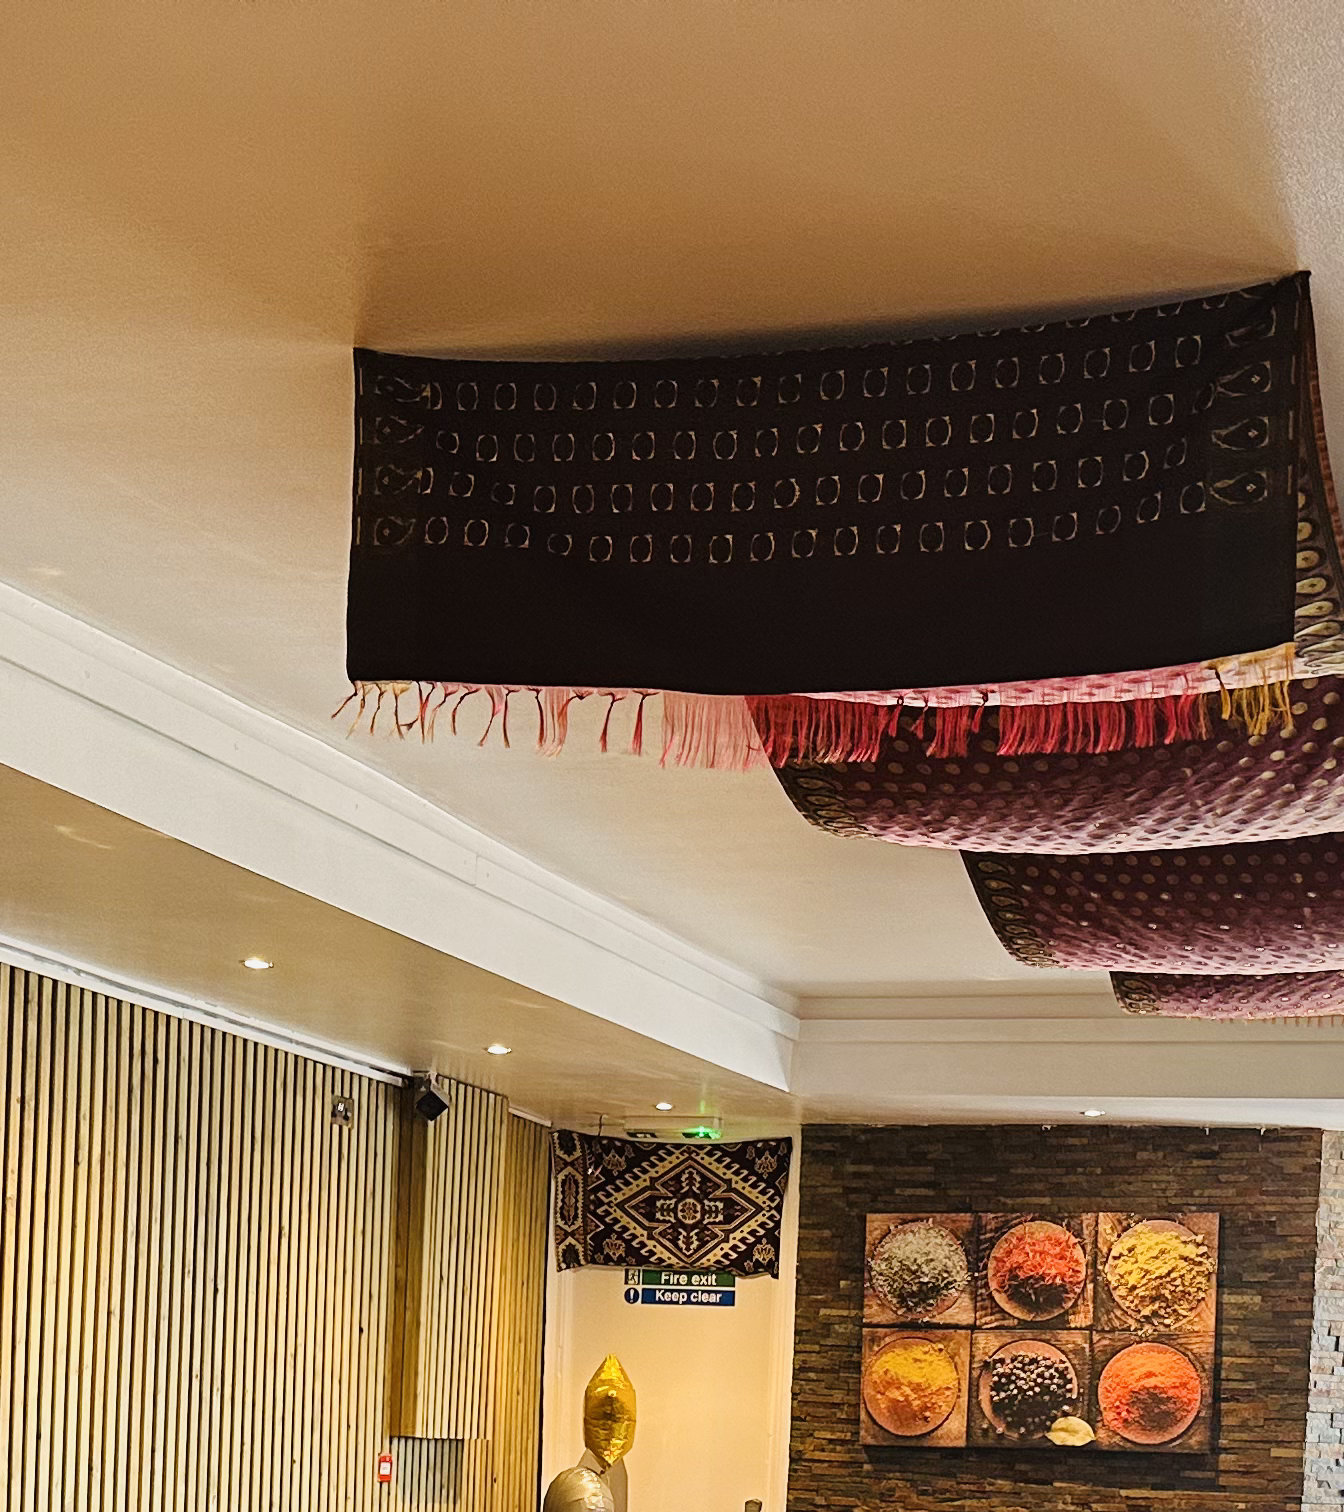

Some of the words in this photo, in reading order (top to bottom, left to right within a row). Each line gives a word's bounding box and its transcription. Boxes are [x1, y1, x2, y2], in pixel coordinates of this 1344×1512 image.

[661, 1271, 688, 1285] Fire
[691, 1272, 717, 1286] exit
[655, 1289, 688, 1304] Keep
[690, 1290, 723, 1303] clear
